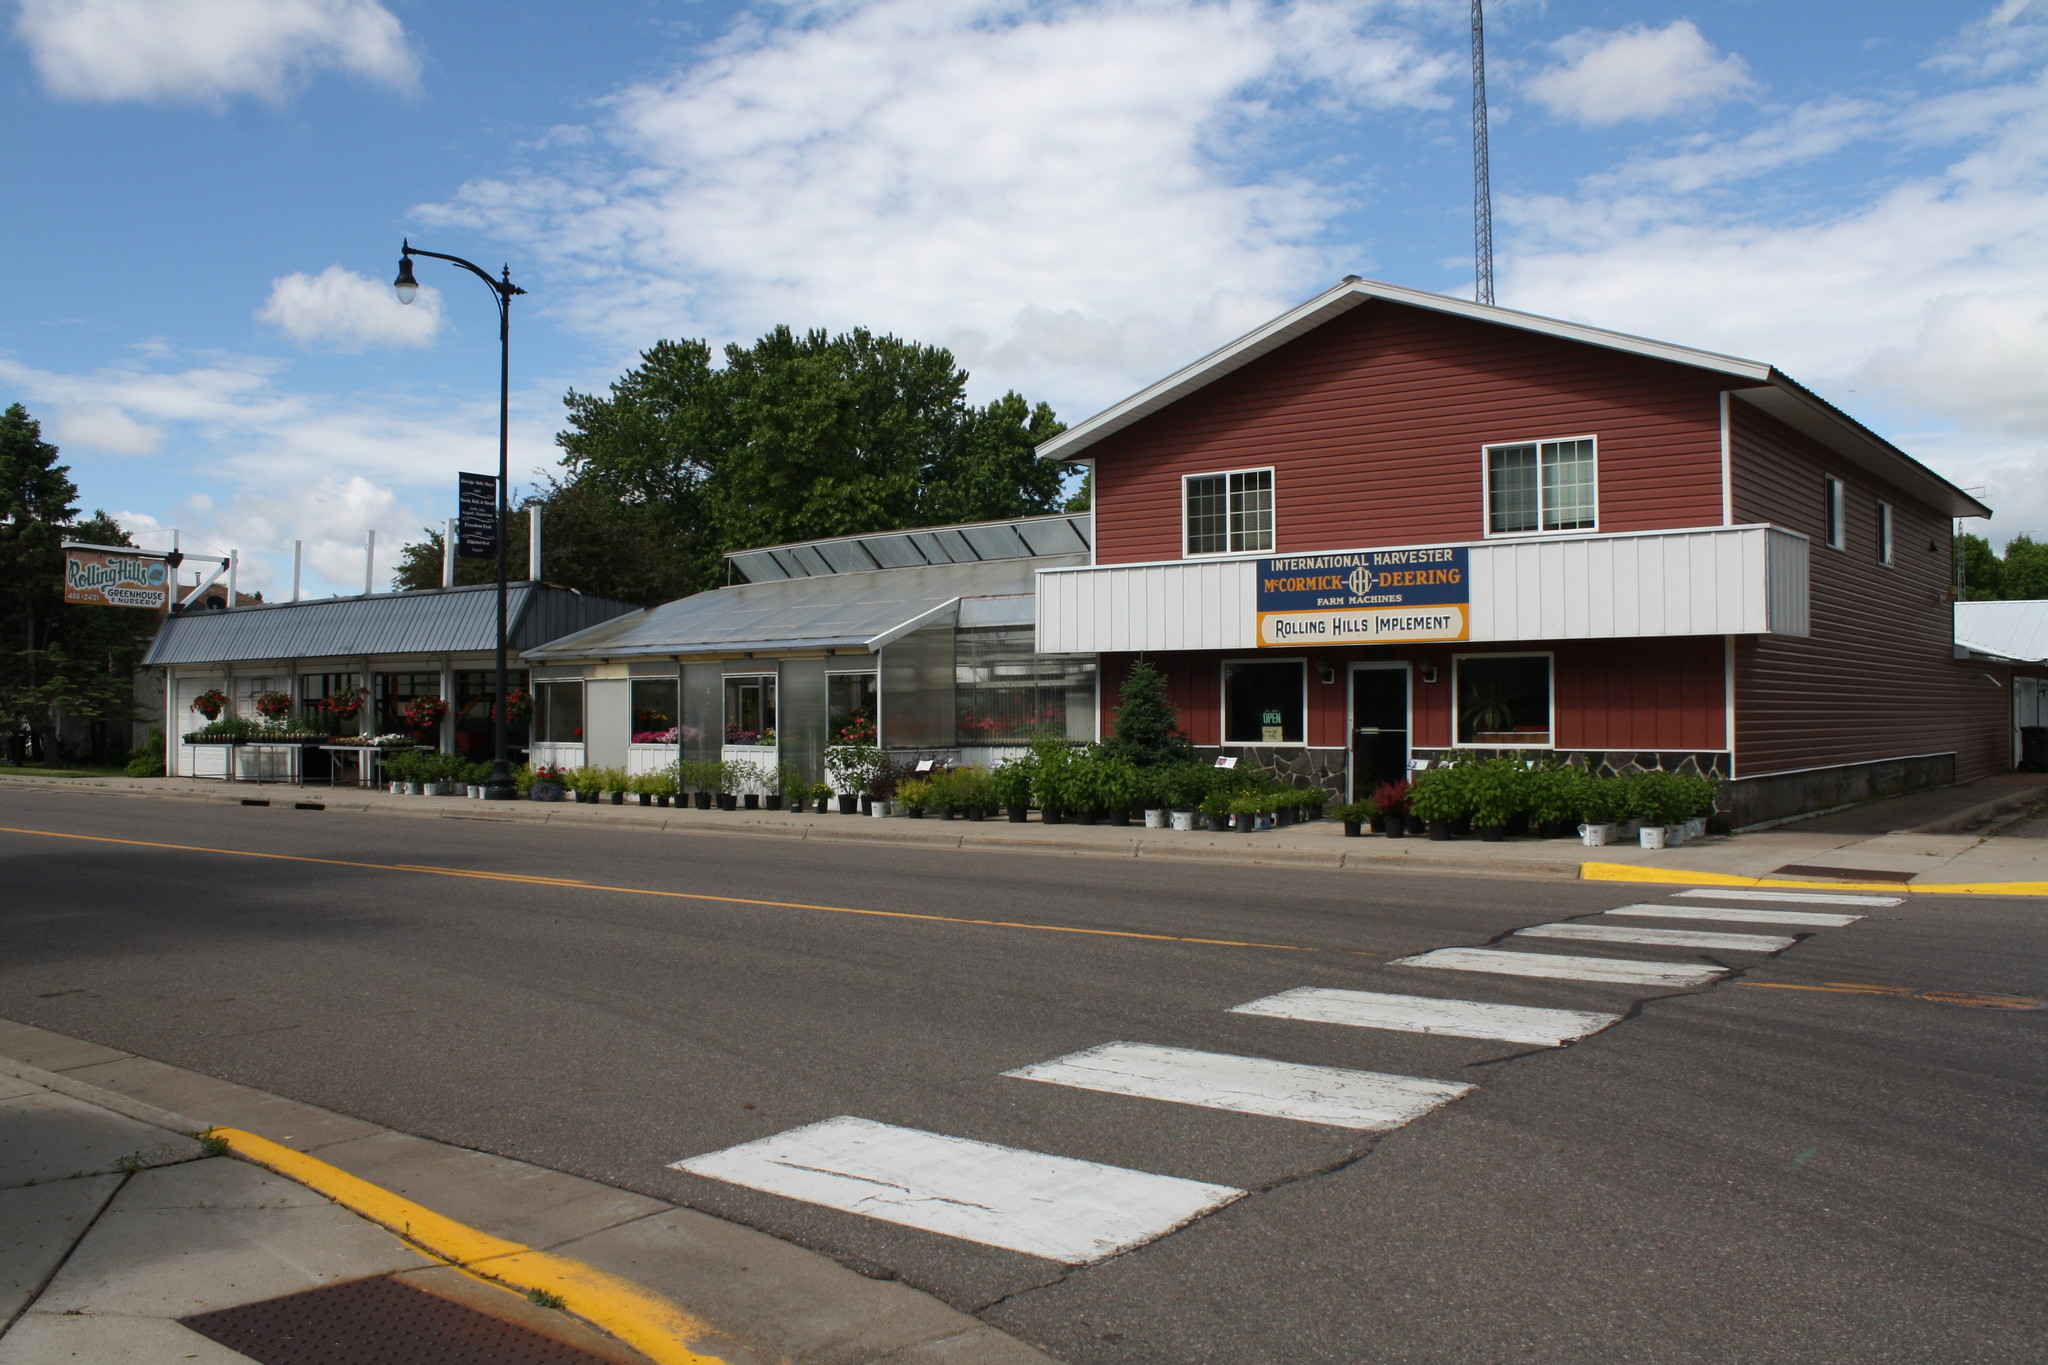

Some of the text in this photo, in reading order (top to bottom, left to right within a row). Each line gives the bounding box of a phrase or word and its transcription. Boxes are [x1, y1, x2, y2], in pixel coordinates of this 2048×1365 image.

[1271, 547, 1454, 572] INTERNATIONAL HARVESTER
[69, 558, 148, 592] Rolling Hills
[107, 588, 163, 601] GREENHOUSE
[1317, 594, 1403, 607] FARM MACHINES
[118, 598, 157, 606] NURSERY
[1275, 616, 1451, 639] ROLLING HILLS IMPLEMENT
[1262, 712, 1281, 724] OPEN
